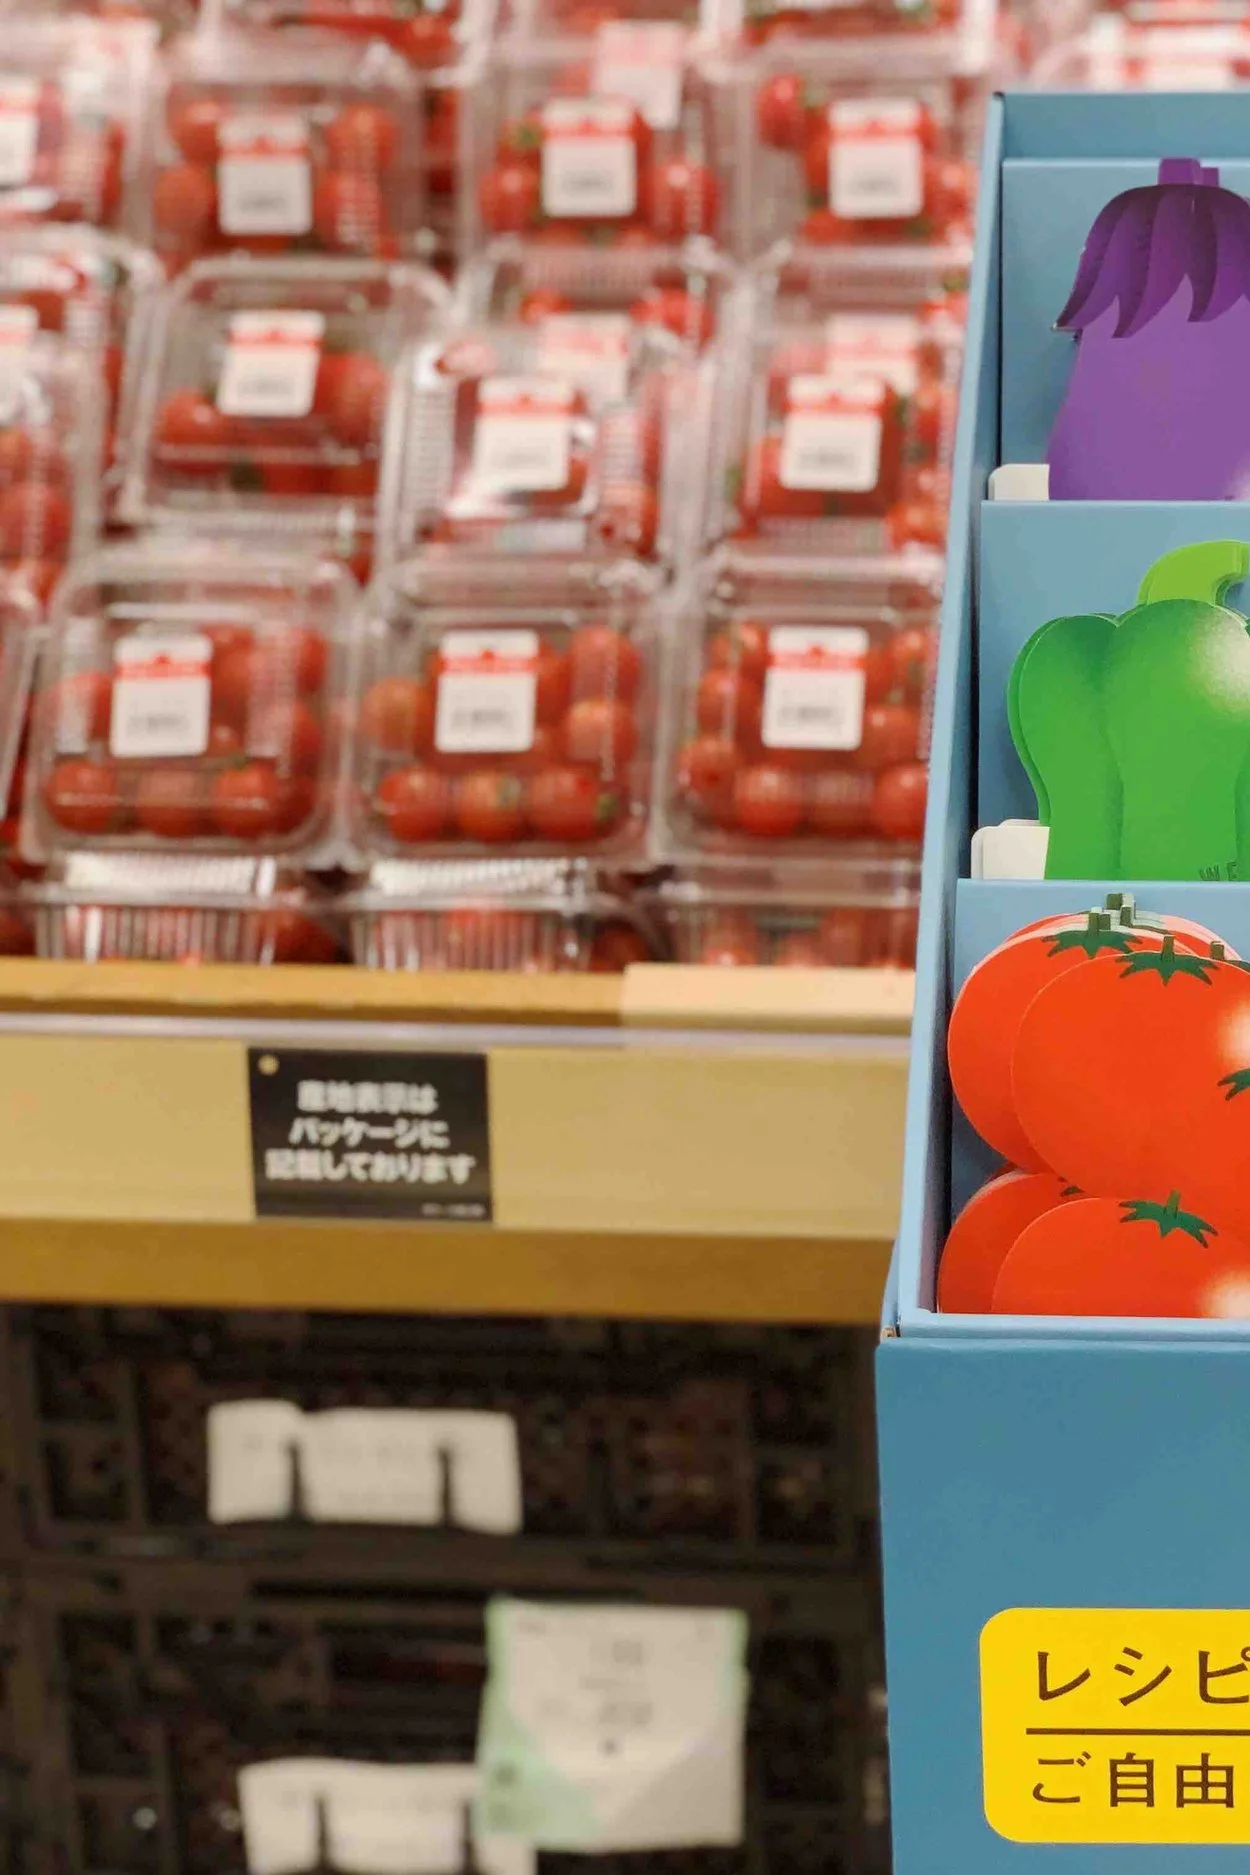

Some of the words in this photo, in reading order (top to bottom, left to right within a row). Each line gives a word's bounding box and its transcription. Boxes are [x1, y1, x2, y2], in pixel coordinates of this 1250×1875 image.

[288, 1117, 450, 1149] パッケージに
